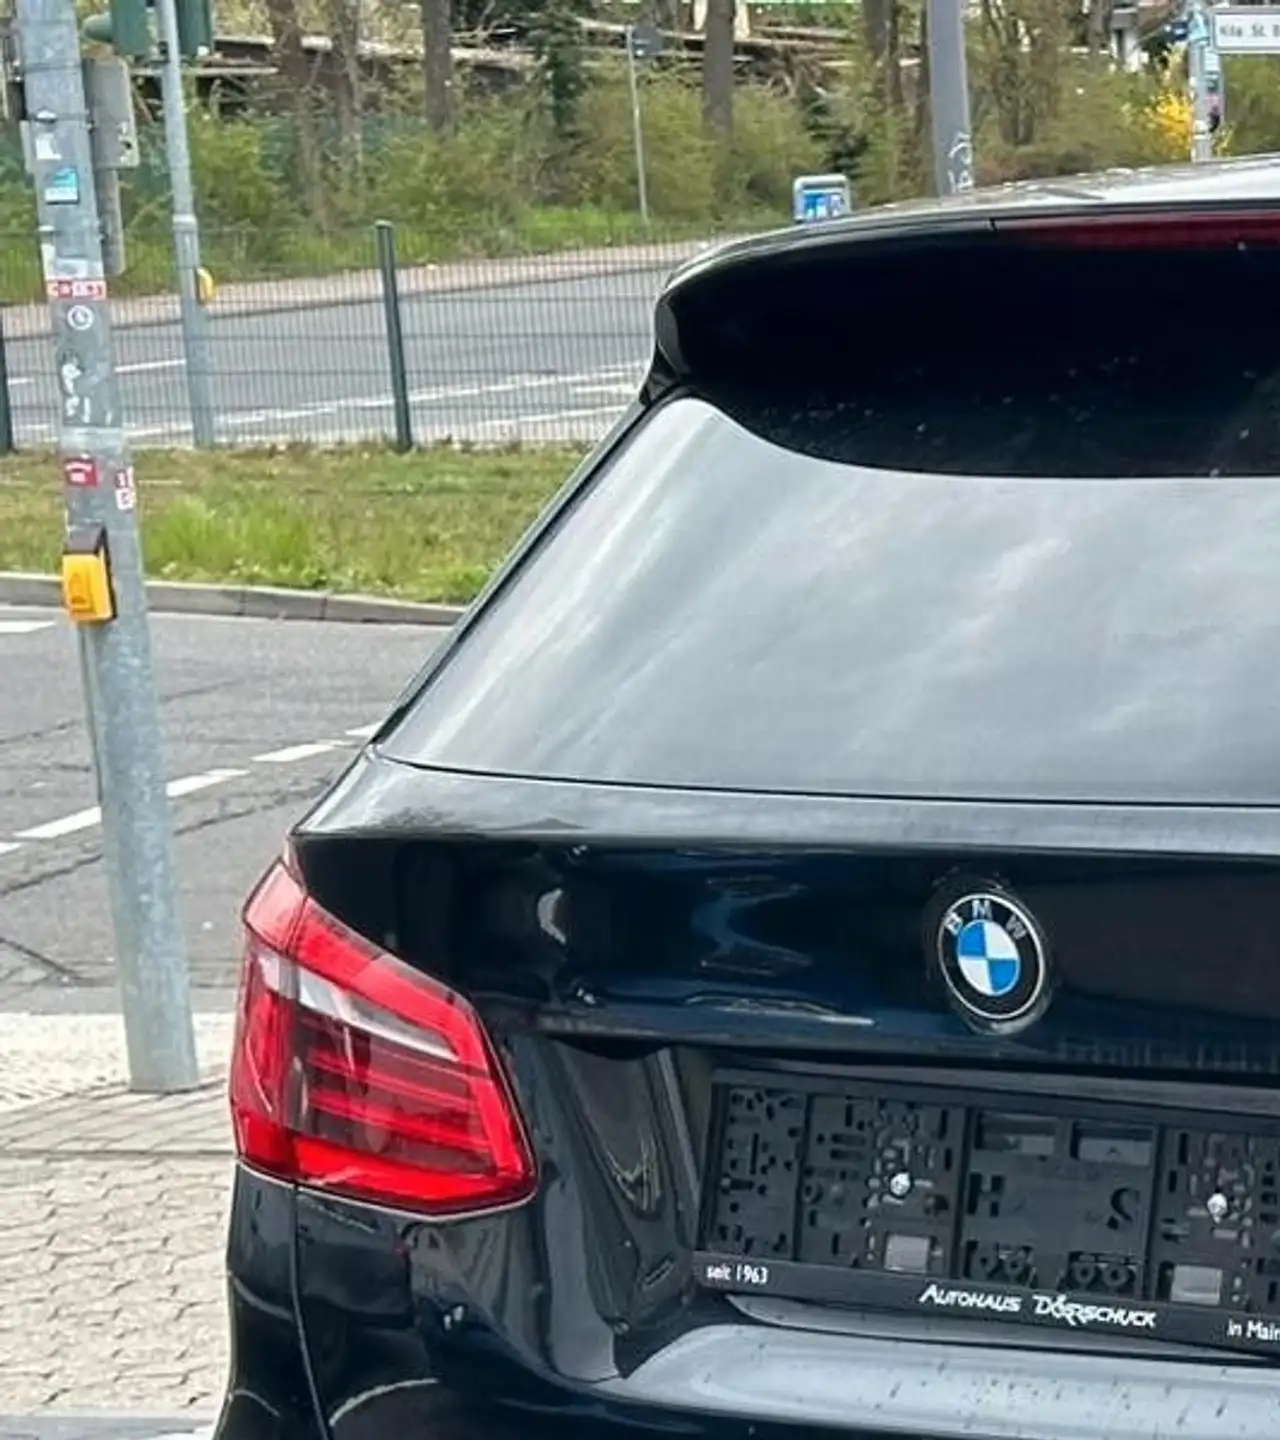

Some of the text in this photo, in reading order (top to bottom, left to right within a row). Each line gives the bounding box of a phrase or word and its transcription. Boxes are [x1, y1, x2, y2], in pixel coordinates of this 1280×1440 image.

[943, 899, 1028, 940] BMW
[706, 1262, 769, 1284] seit 1963
[1226, 1318, 1242, 1337] in
